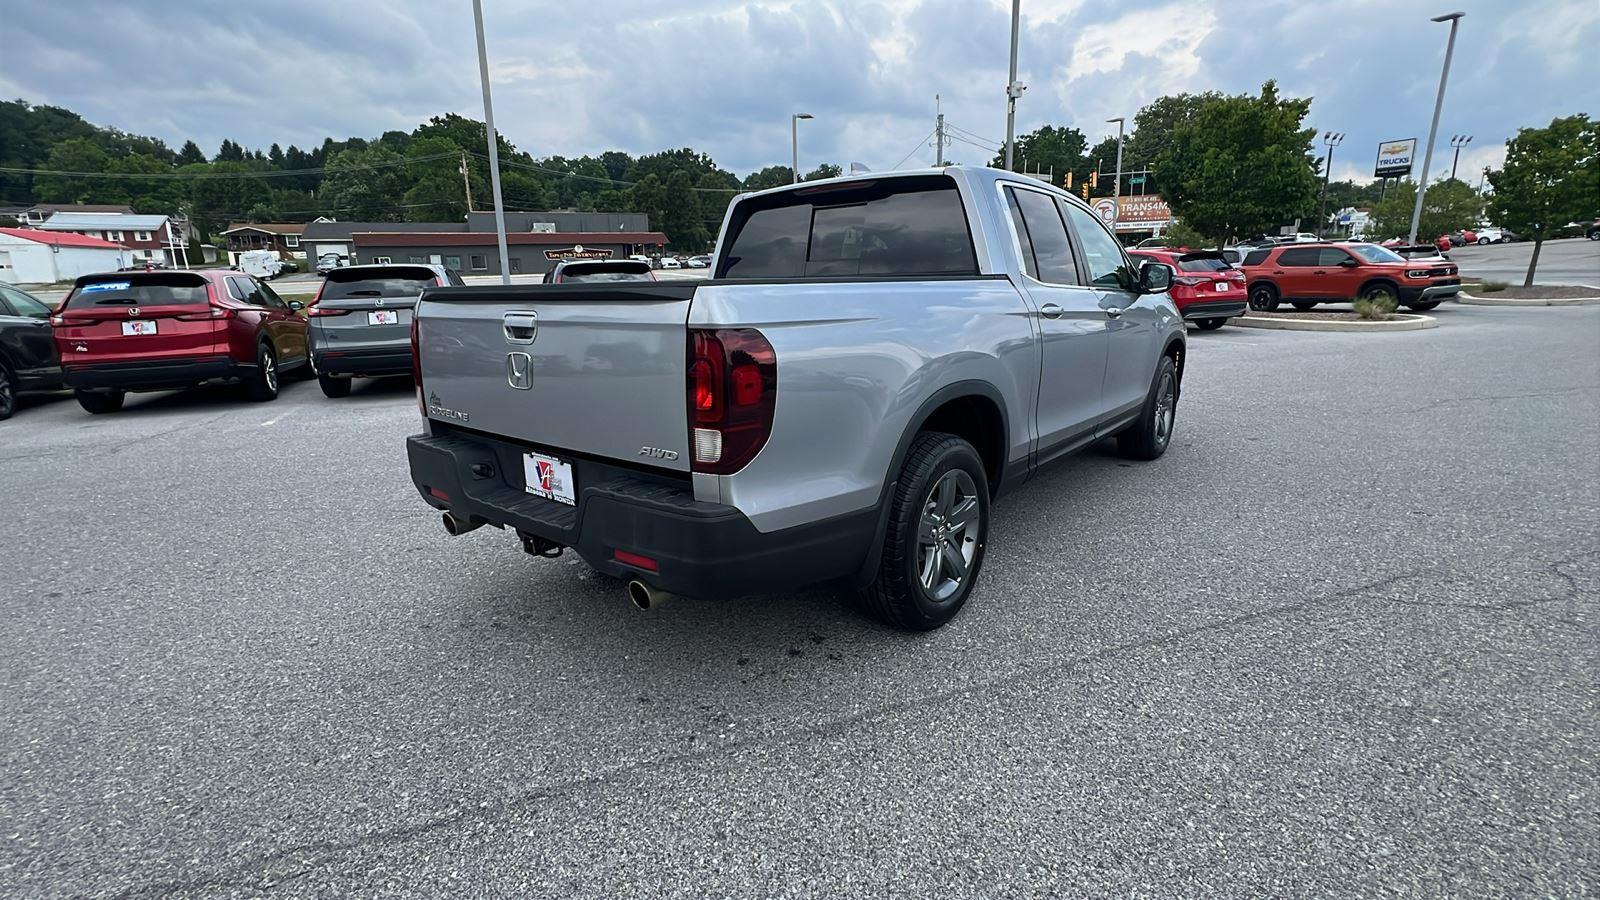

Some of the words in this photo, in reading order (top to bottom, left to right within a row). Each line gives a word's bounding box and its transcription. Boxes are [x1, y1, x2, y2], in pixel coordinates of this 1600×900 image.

[1380, 157, 1409, 166] TRUCKS
[430, 405, 470, 422] RIDGELINE
[638, 446, 679, 461] AWD
